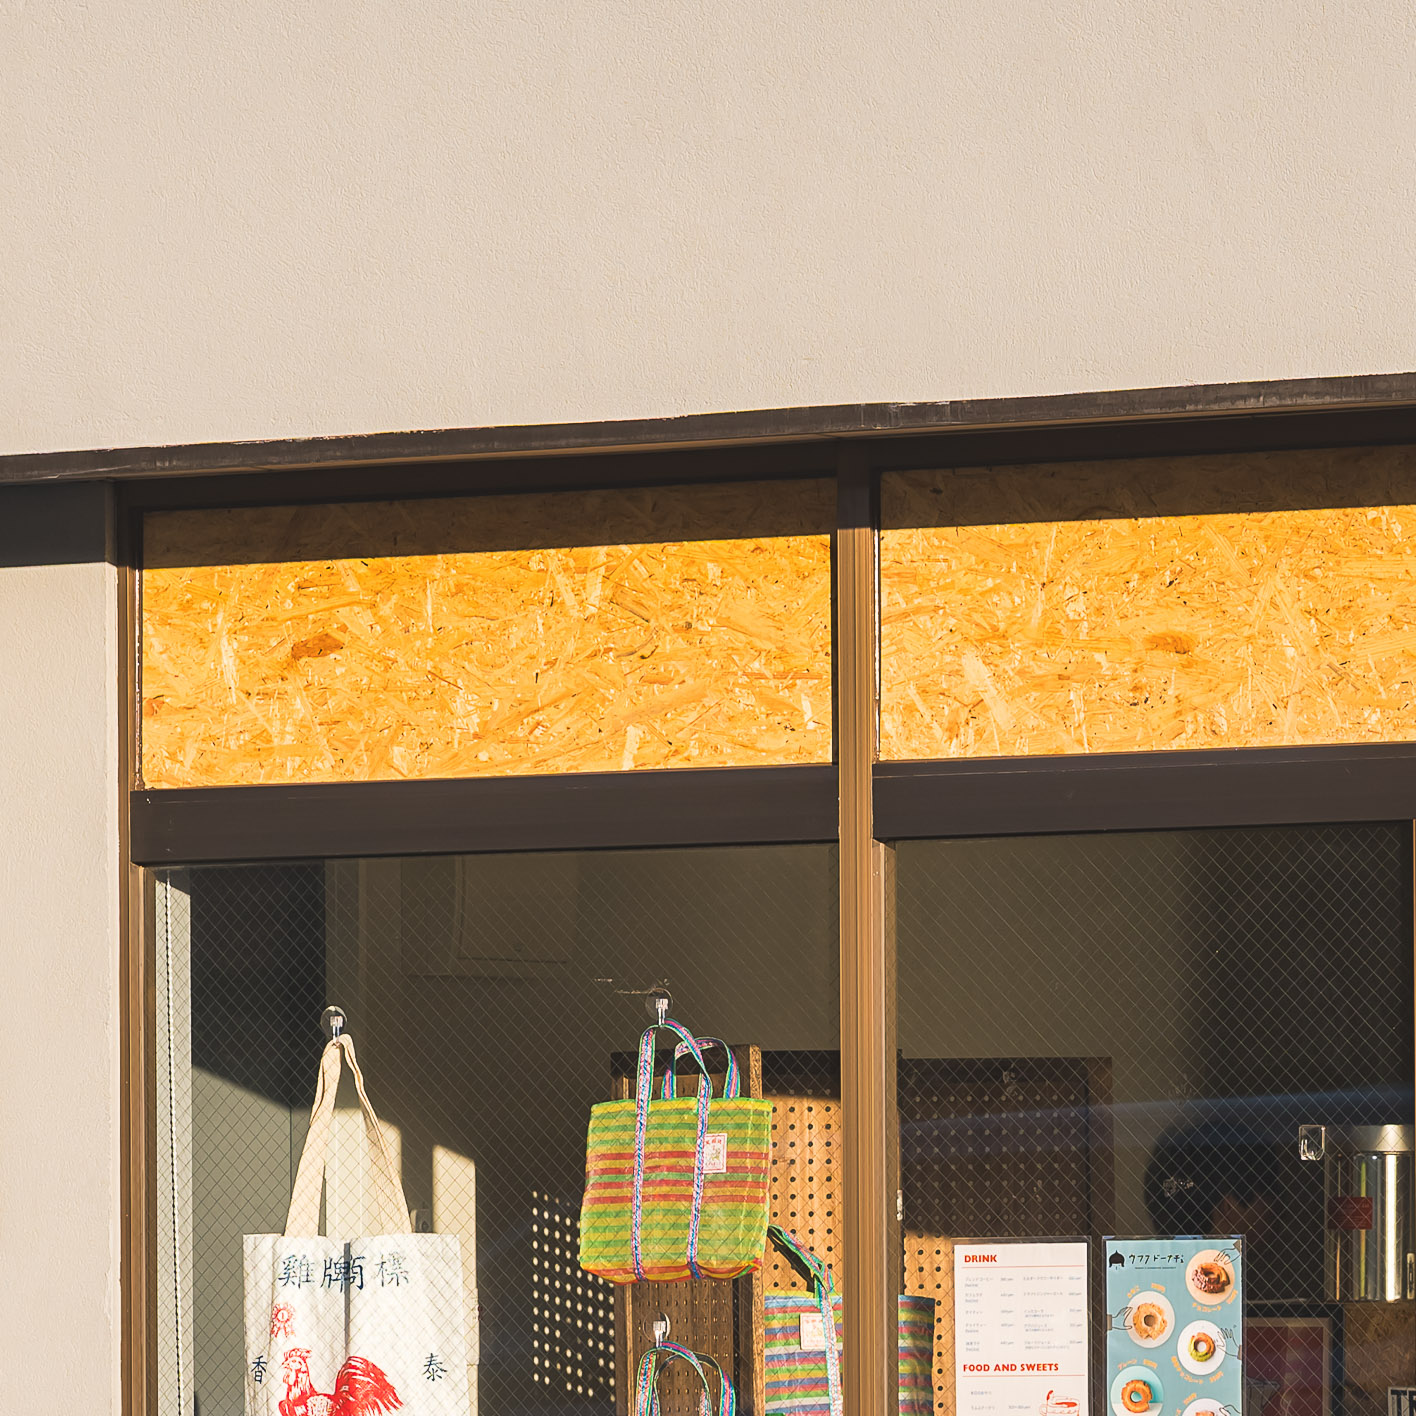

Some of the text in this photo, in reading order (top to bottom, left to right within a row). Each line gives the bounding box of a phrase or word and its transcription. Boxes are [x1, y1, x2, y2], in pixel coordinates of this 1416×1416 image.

[964, 1254, 998, 1263] DRINK
[963, 1362, 1059, 1373] FOOD AND SWEETS
